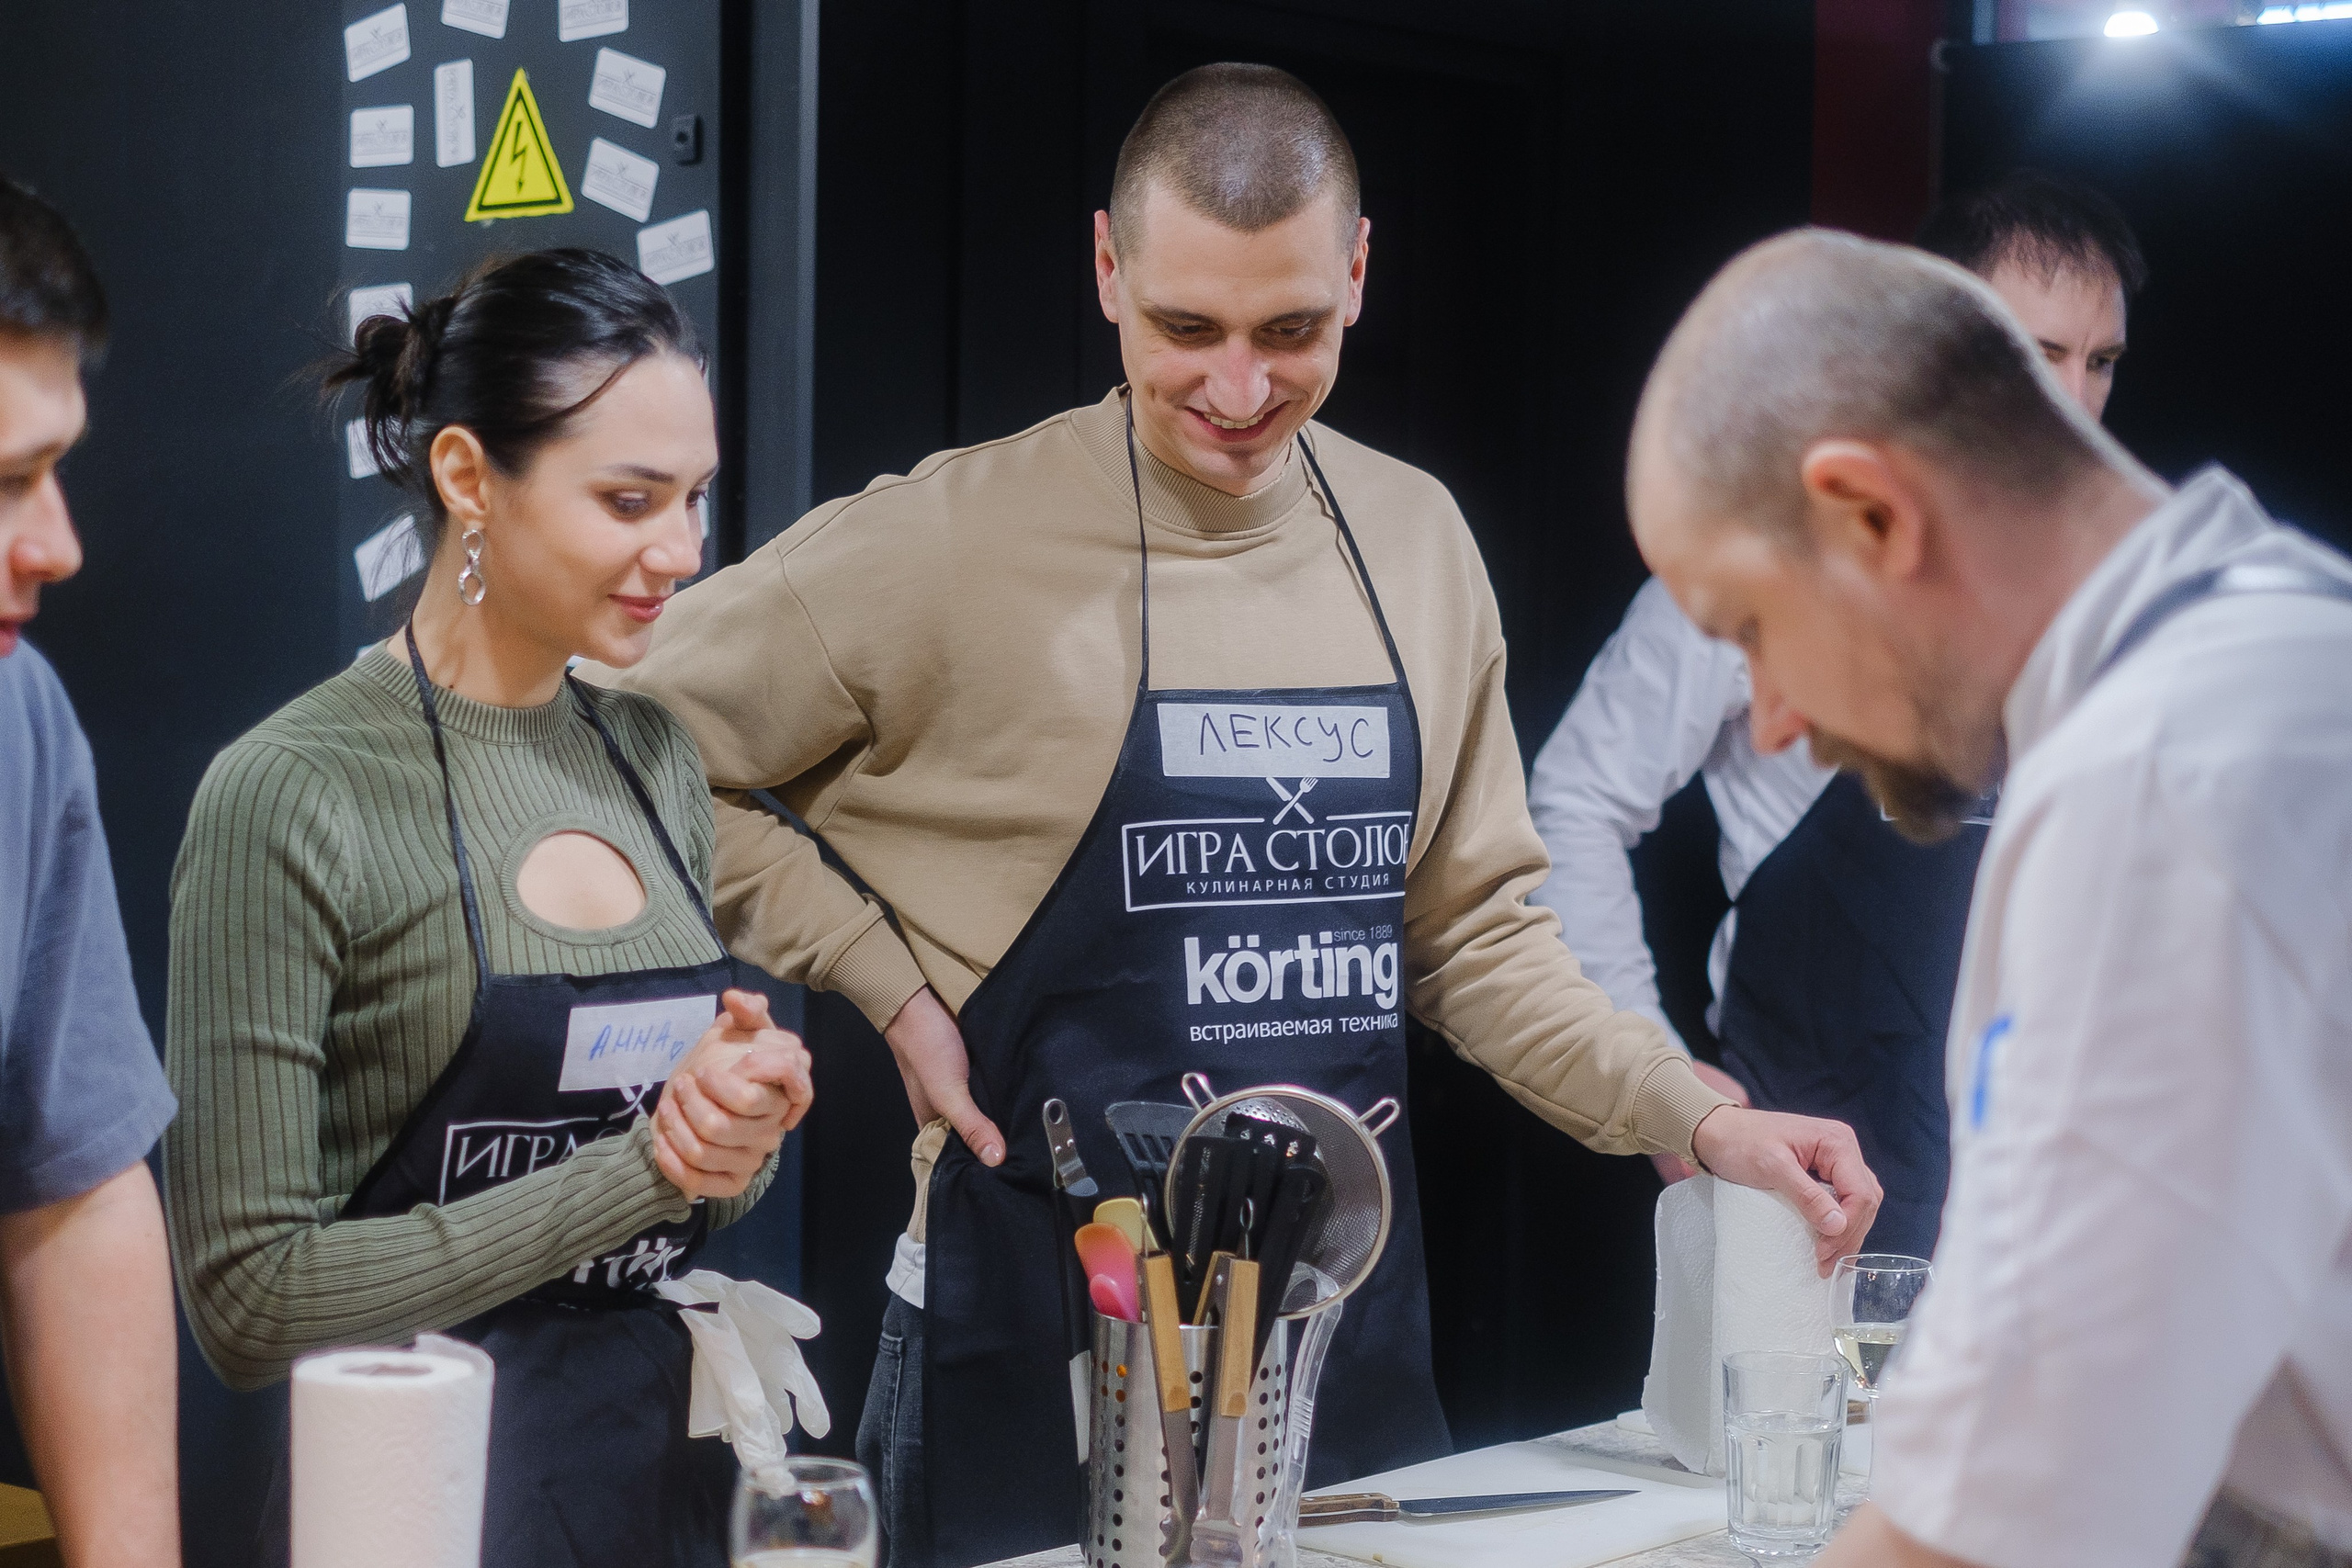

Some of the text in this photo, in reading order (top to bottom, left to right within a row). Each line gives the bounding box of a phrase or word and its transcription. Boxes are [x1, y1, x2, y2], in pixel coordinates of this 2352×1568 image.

[1199, 712, 1374, 763] ЛЕКСУС
[1136, 830, 1257, 876] ИГРА
[1186, 873, 1390, 895] КУЛИНАРНАЯ СТУДИЯ
[1333, 924, 1393, 942] since 1889
[1183, 931, 1398, 1010] körting
[1189, 1011, 1398, 1044] встраиваемая техника
